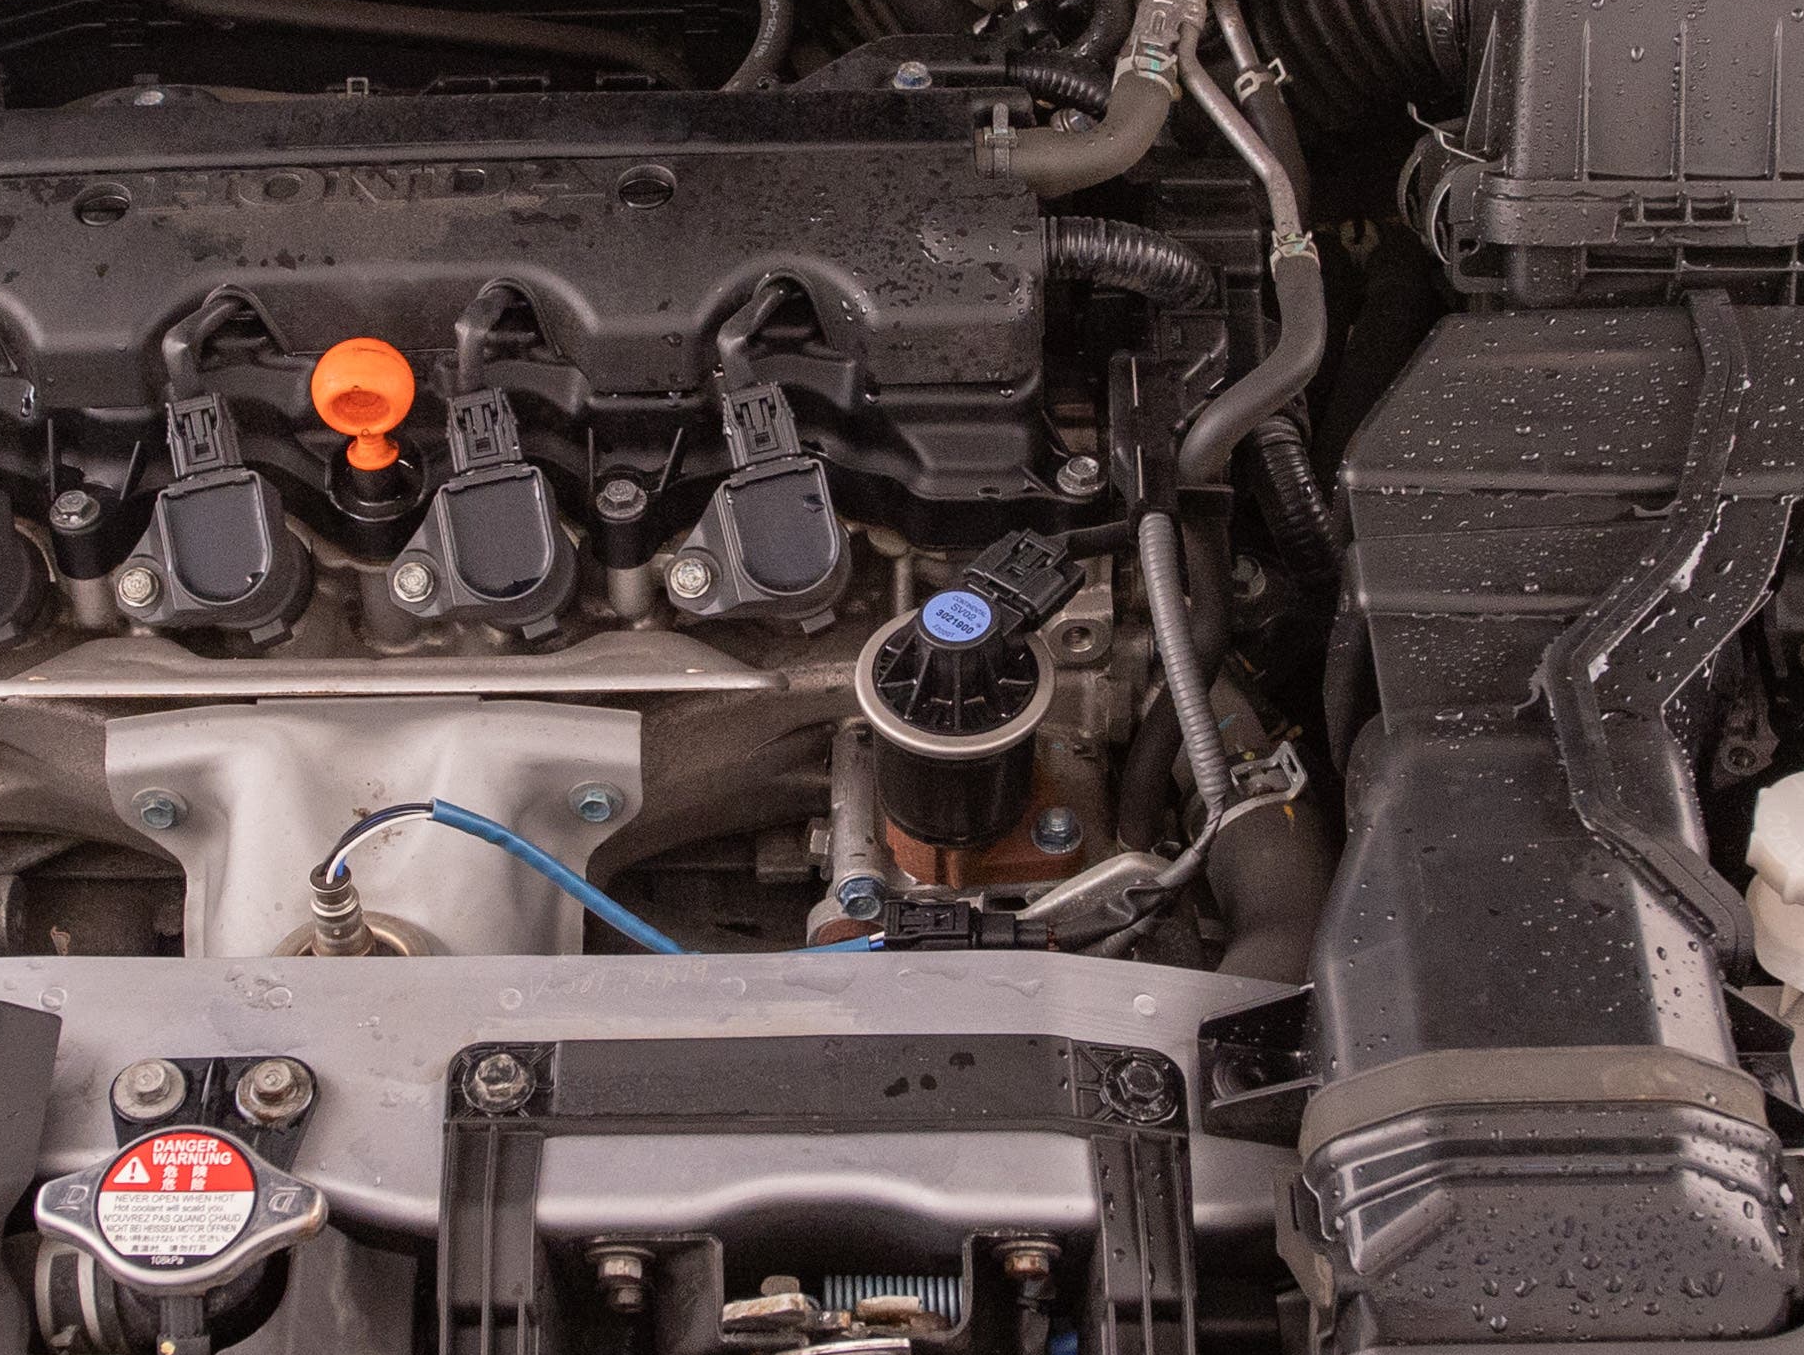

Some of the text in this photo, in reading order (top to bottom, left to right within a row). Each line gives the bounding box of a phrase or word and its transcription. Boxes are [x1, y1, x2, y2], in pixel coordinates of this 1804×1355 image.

[136, 162, 609, 214] HONDA
[950, 604, 977, 621] SV02
[935, 610, 975, 634] 3021900
[153, 1140, 219, 1152] DANGER
[152, 1152, 232, 1165] WARNUNG
[103, 1214, 150, 1222] N'OUVREZ
[153, 1214, 171, 1222] PAS
[173, 1214, 206, 1223] QUAND
[151, 1256, 185, 1265] 108kPa
